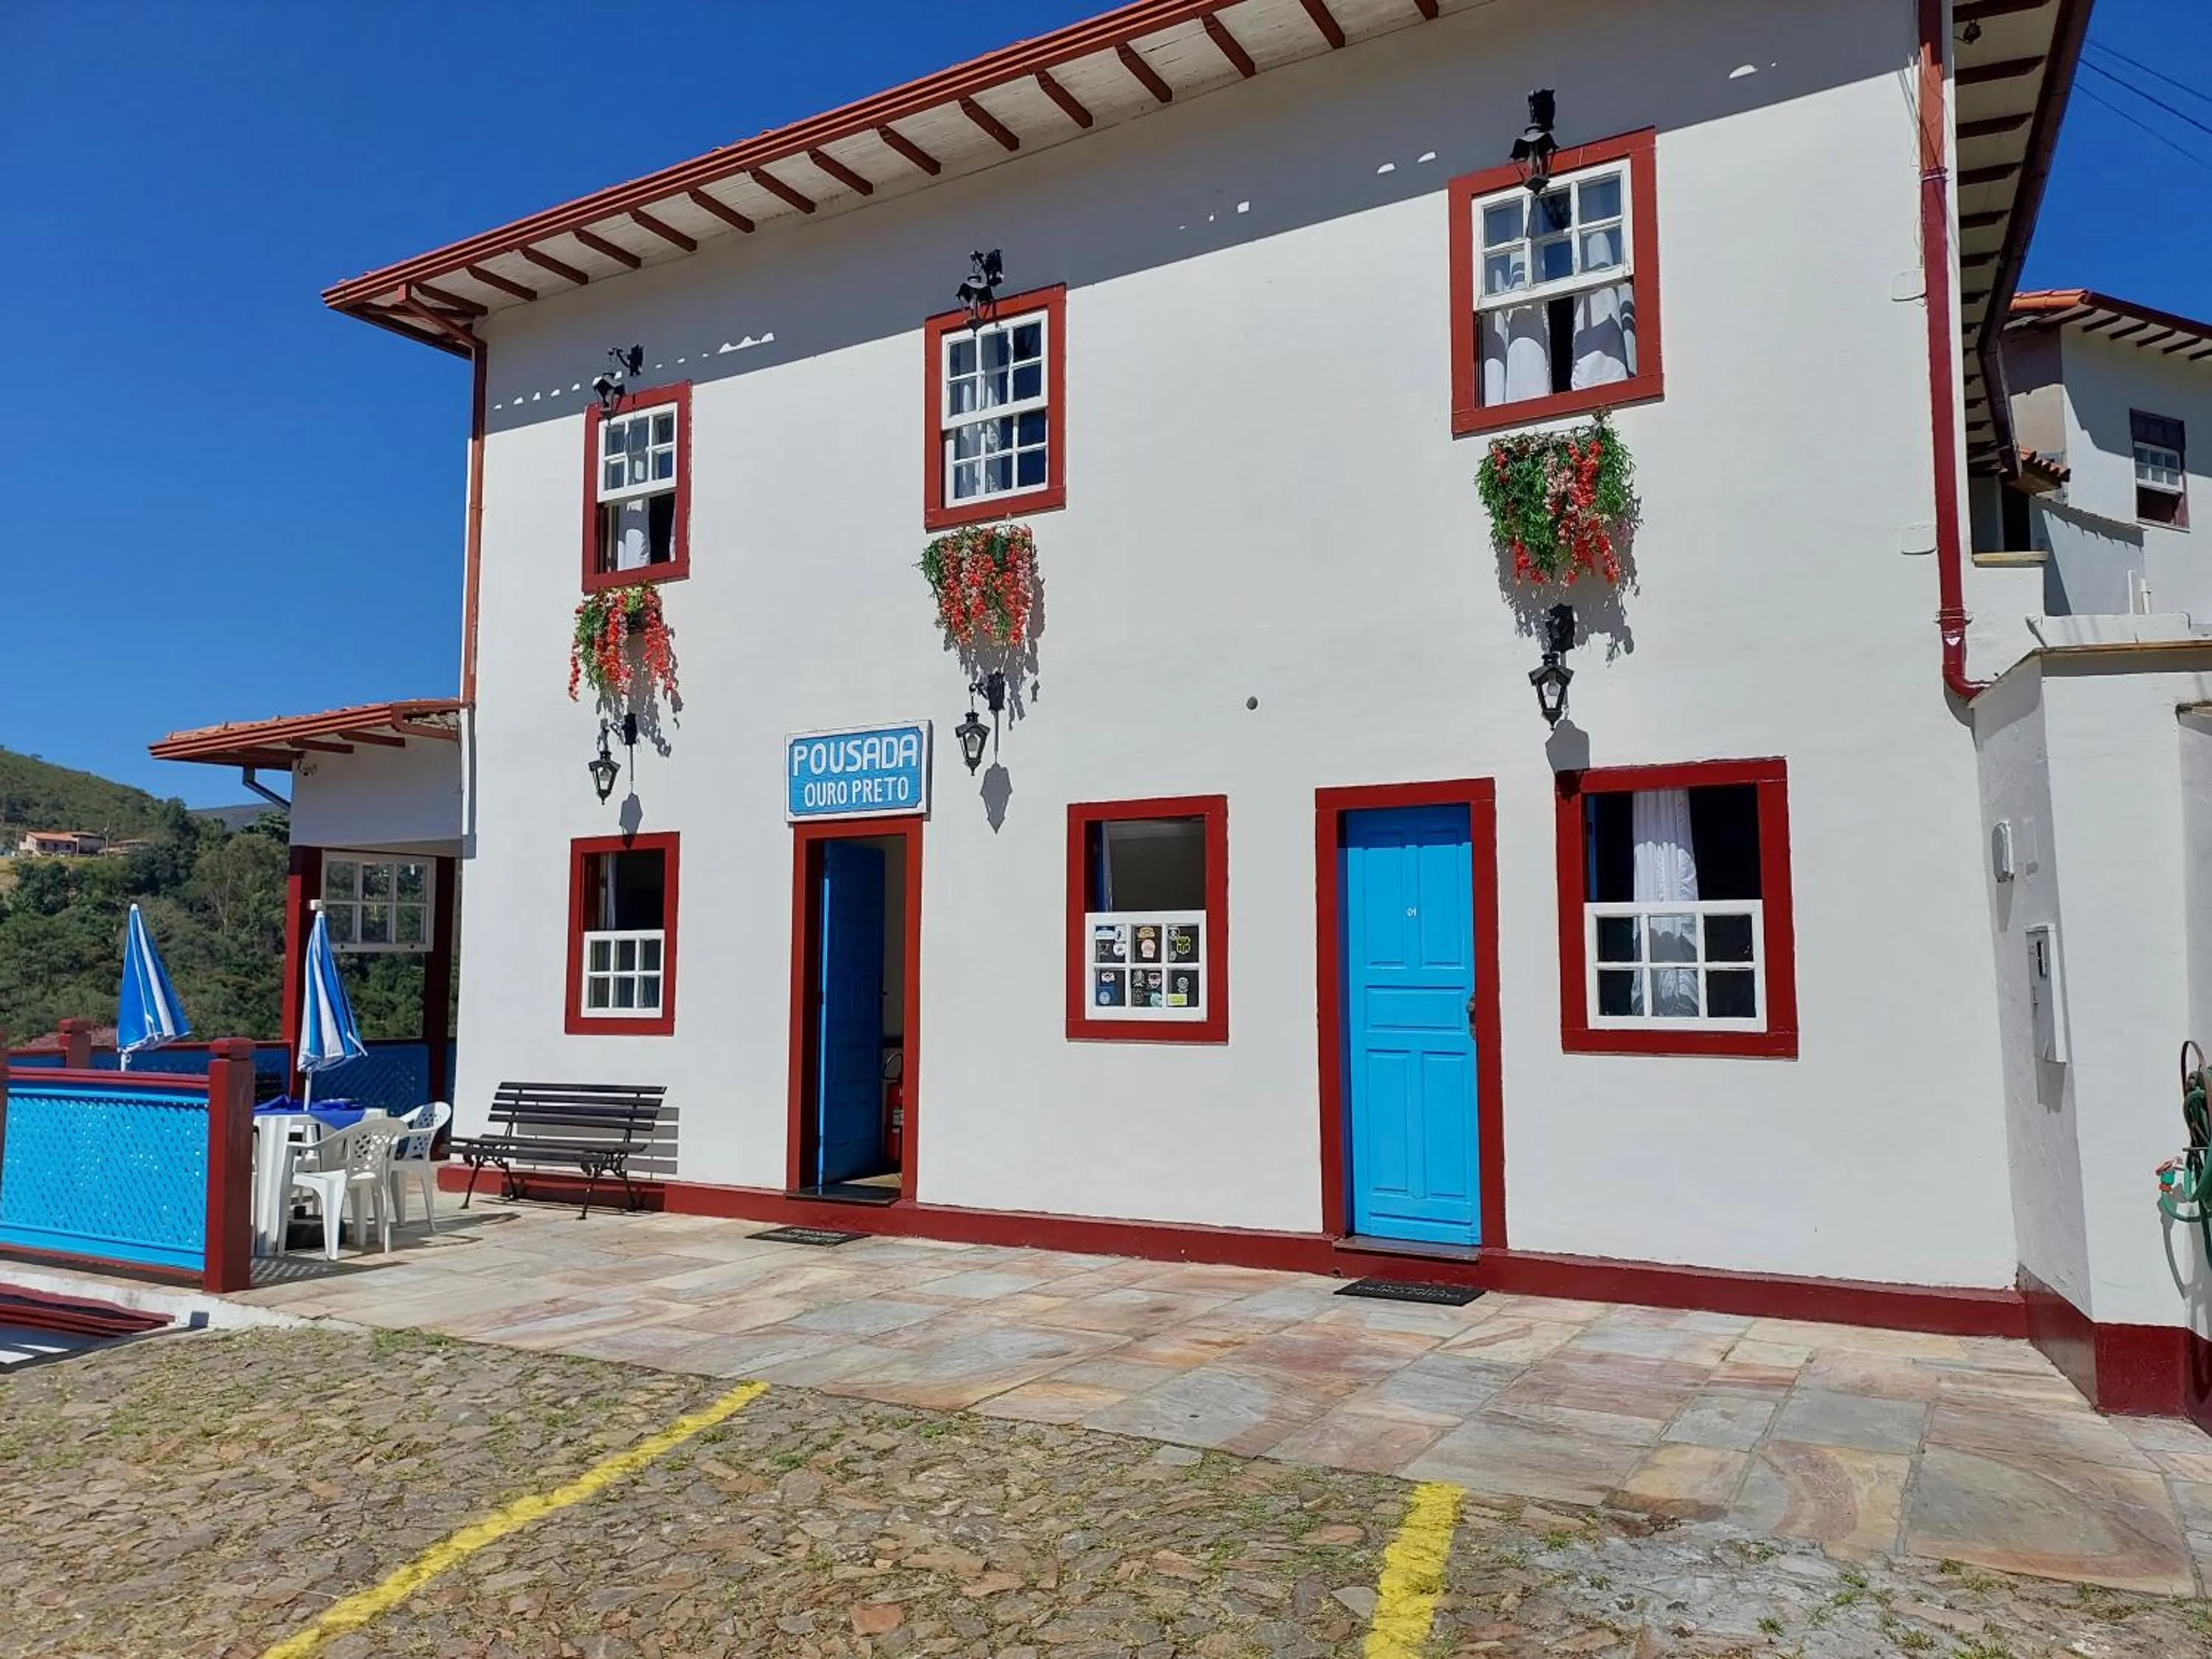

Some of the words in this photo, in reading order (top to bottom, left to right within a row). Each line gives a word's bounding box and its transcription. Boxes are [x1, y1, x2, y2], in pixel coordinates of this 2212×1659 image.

[793, 734, 917, 776] POUSADA
[804, 780, 847, 807] OURO
[852, 776, 909, 804] PRETO
